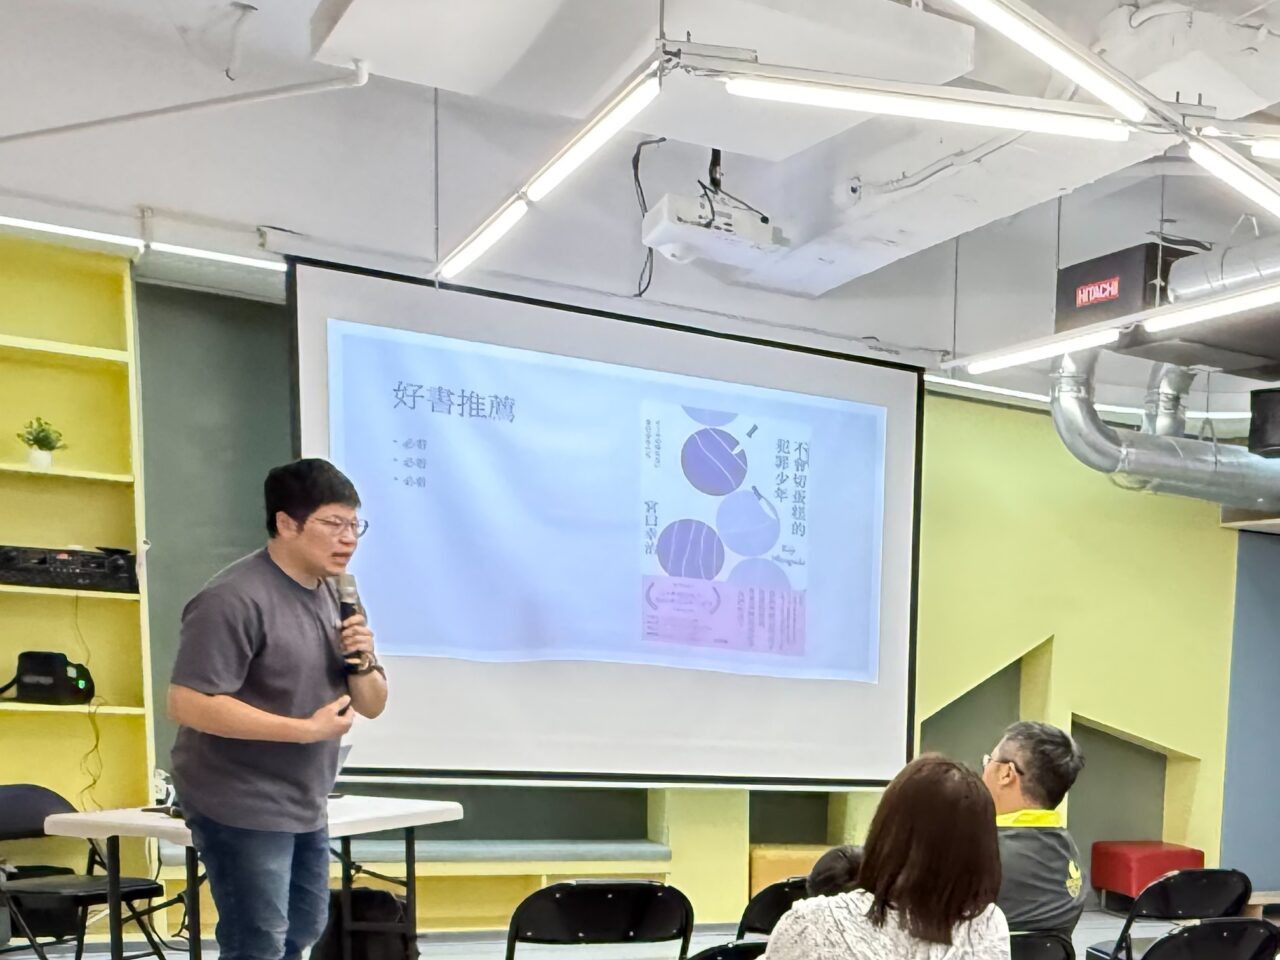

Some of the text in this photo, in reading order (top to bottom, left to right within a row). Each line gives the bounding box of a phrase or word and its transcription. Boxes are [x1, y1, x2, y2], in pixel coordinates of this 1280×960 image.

[1077, 278, 1119, 305] HITACHI
[393, 380, 515, 423] 好書推薦
